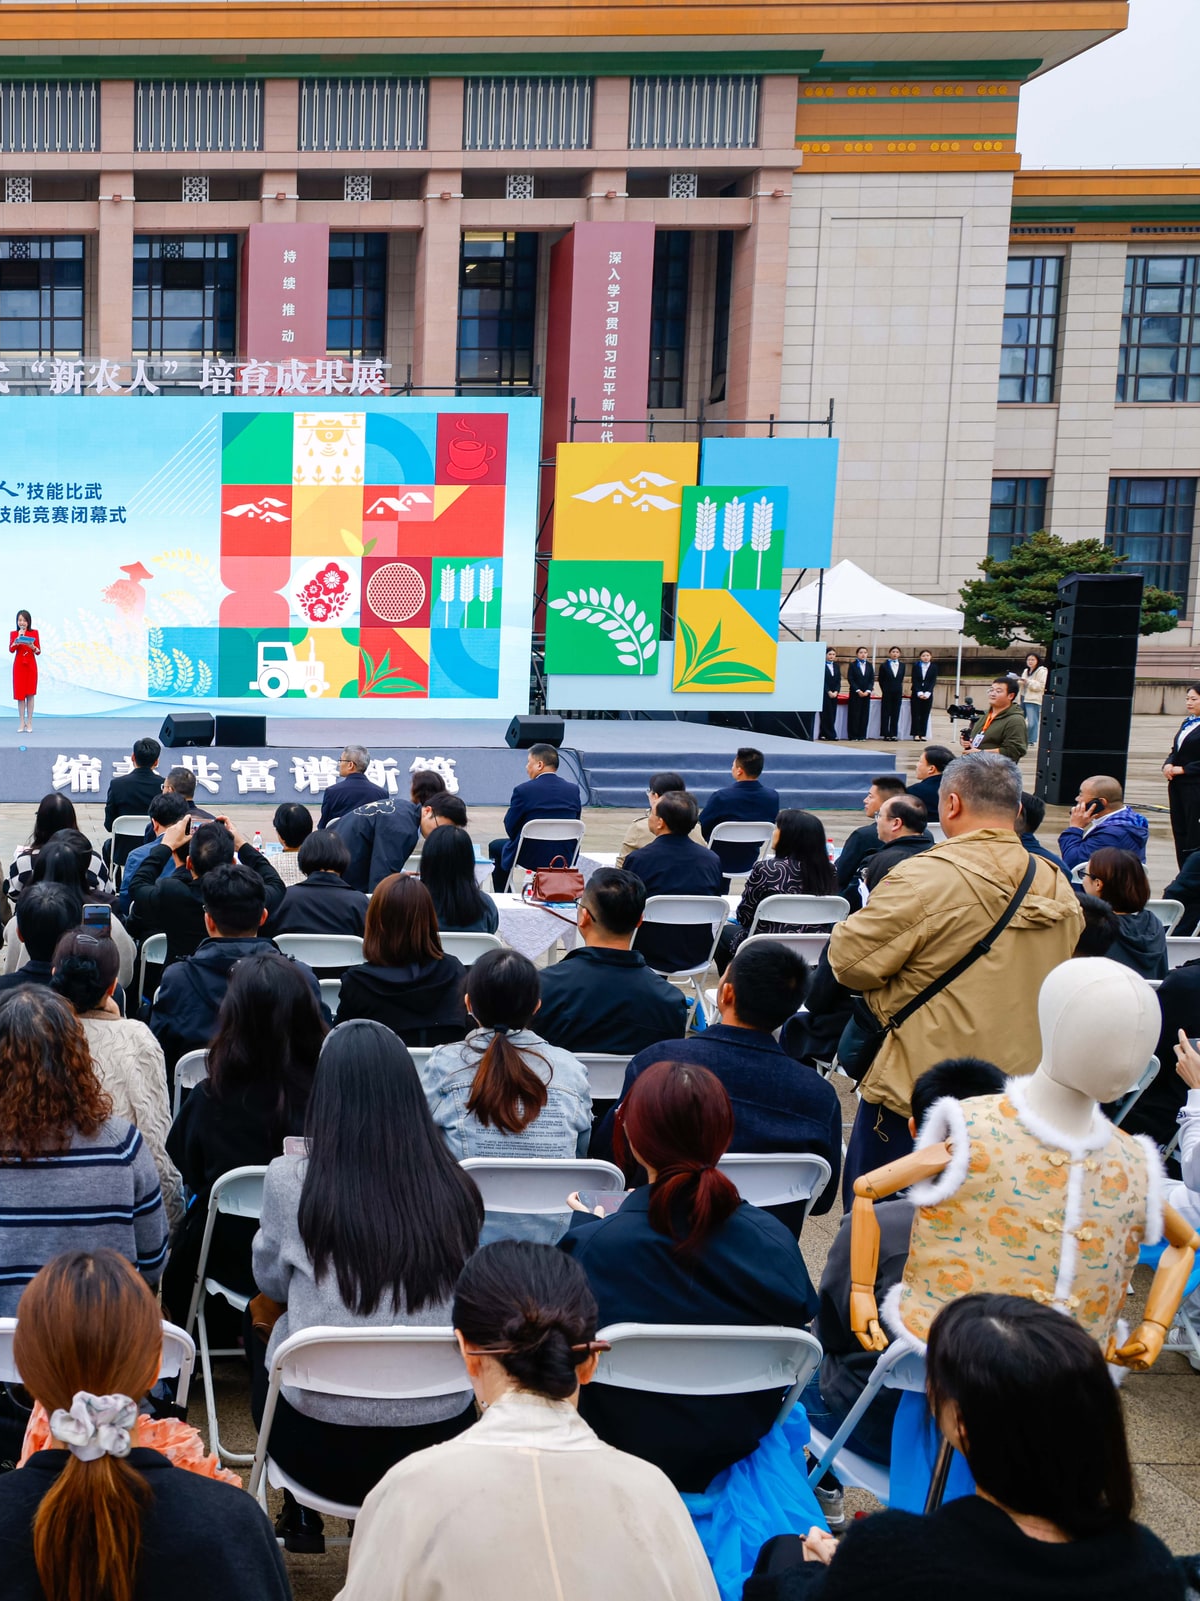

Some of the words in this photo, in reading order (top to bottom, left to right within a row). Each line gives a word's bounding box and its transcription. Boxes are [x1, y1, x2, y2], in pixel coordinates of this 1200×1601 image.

[281, 249, 297, 343] 持续推动
[600, 251, 622, 443] 深入学习贯彻习近平新时代
